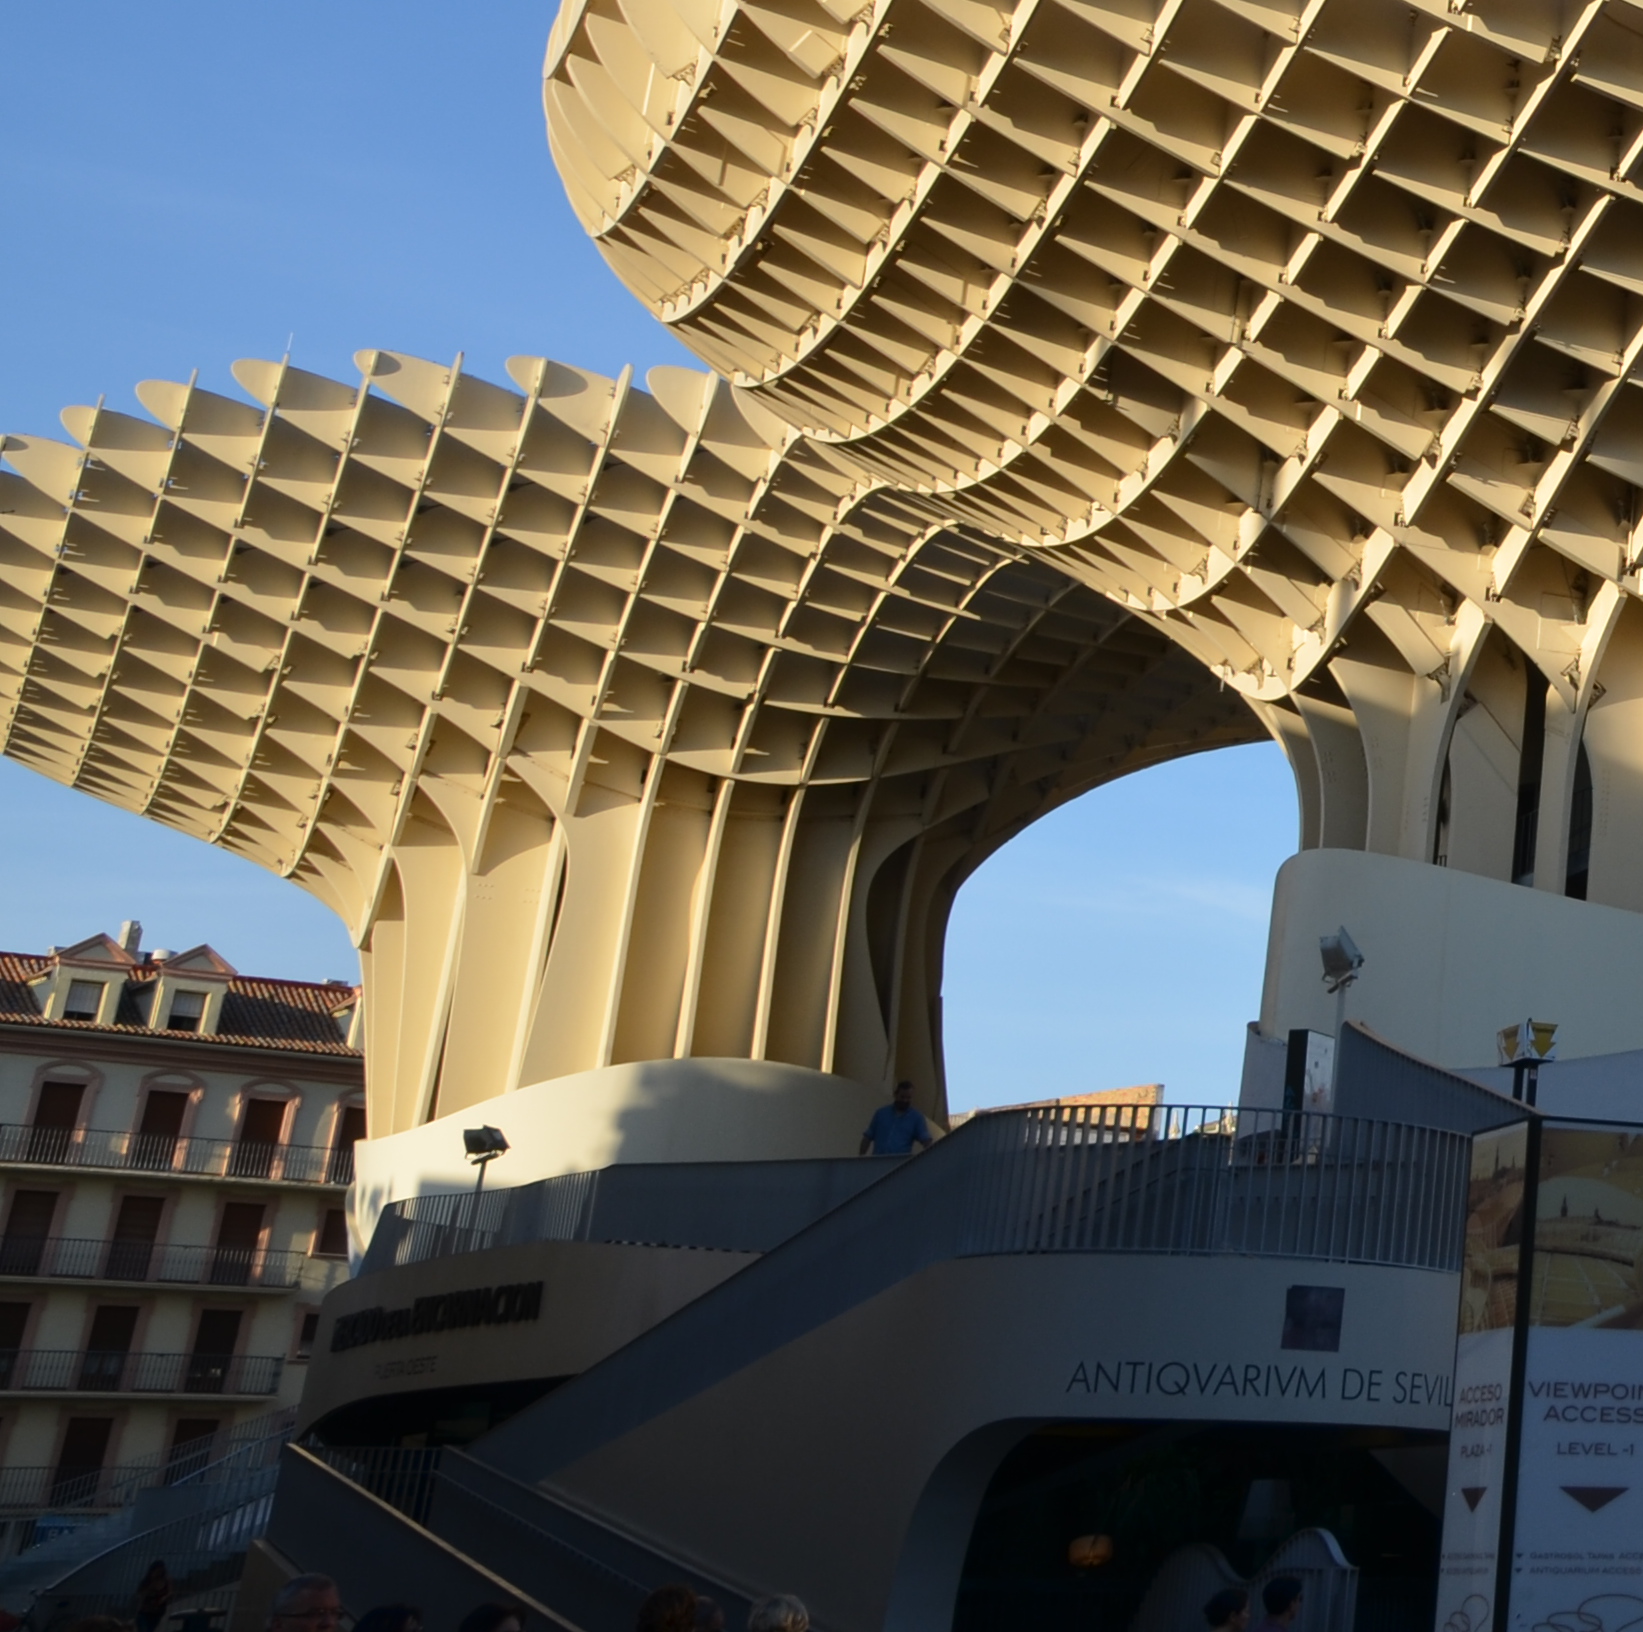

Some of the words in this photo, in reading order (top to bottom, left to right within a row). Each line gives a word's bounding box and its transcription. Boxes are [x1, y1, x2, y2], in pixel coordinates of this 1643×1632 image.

[1065, 1360, 1327, 1399] ANTIQVARIVM
[1341, 1368, 1383, 1402] DE
[1458, 1383, 1503, 1404] ACCESO
[1454, 1407, 1505, 1429] MIRADOR
[1460, 1443, 1485, 1457] PLAZA
[1556, 1442, 1618, 1456] LEVEL
[1622, 1443, 1635, 1456] -1
[1601, 1567, 1643, 1575] ACCESS
